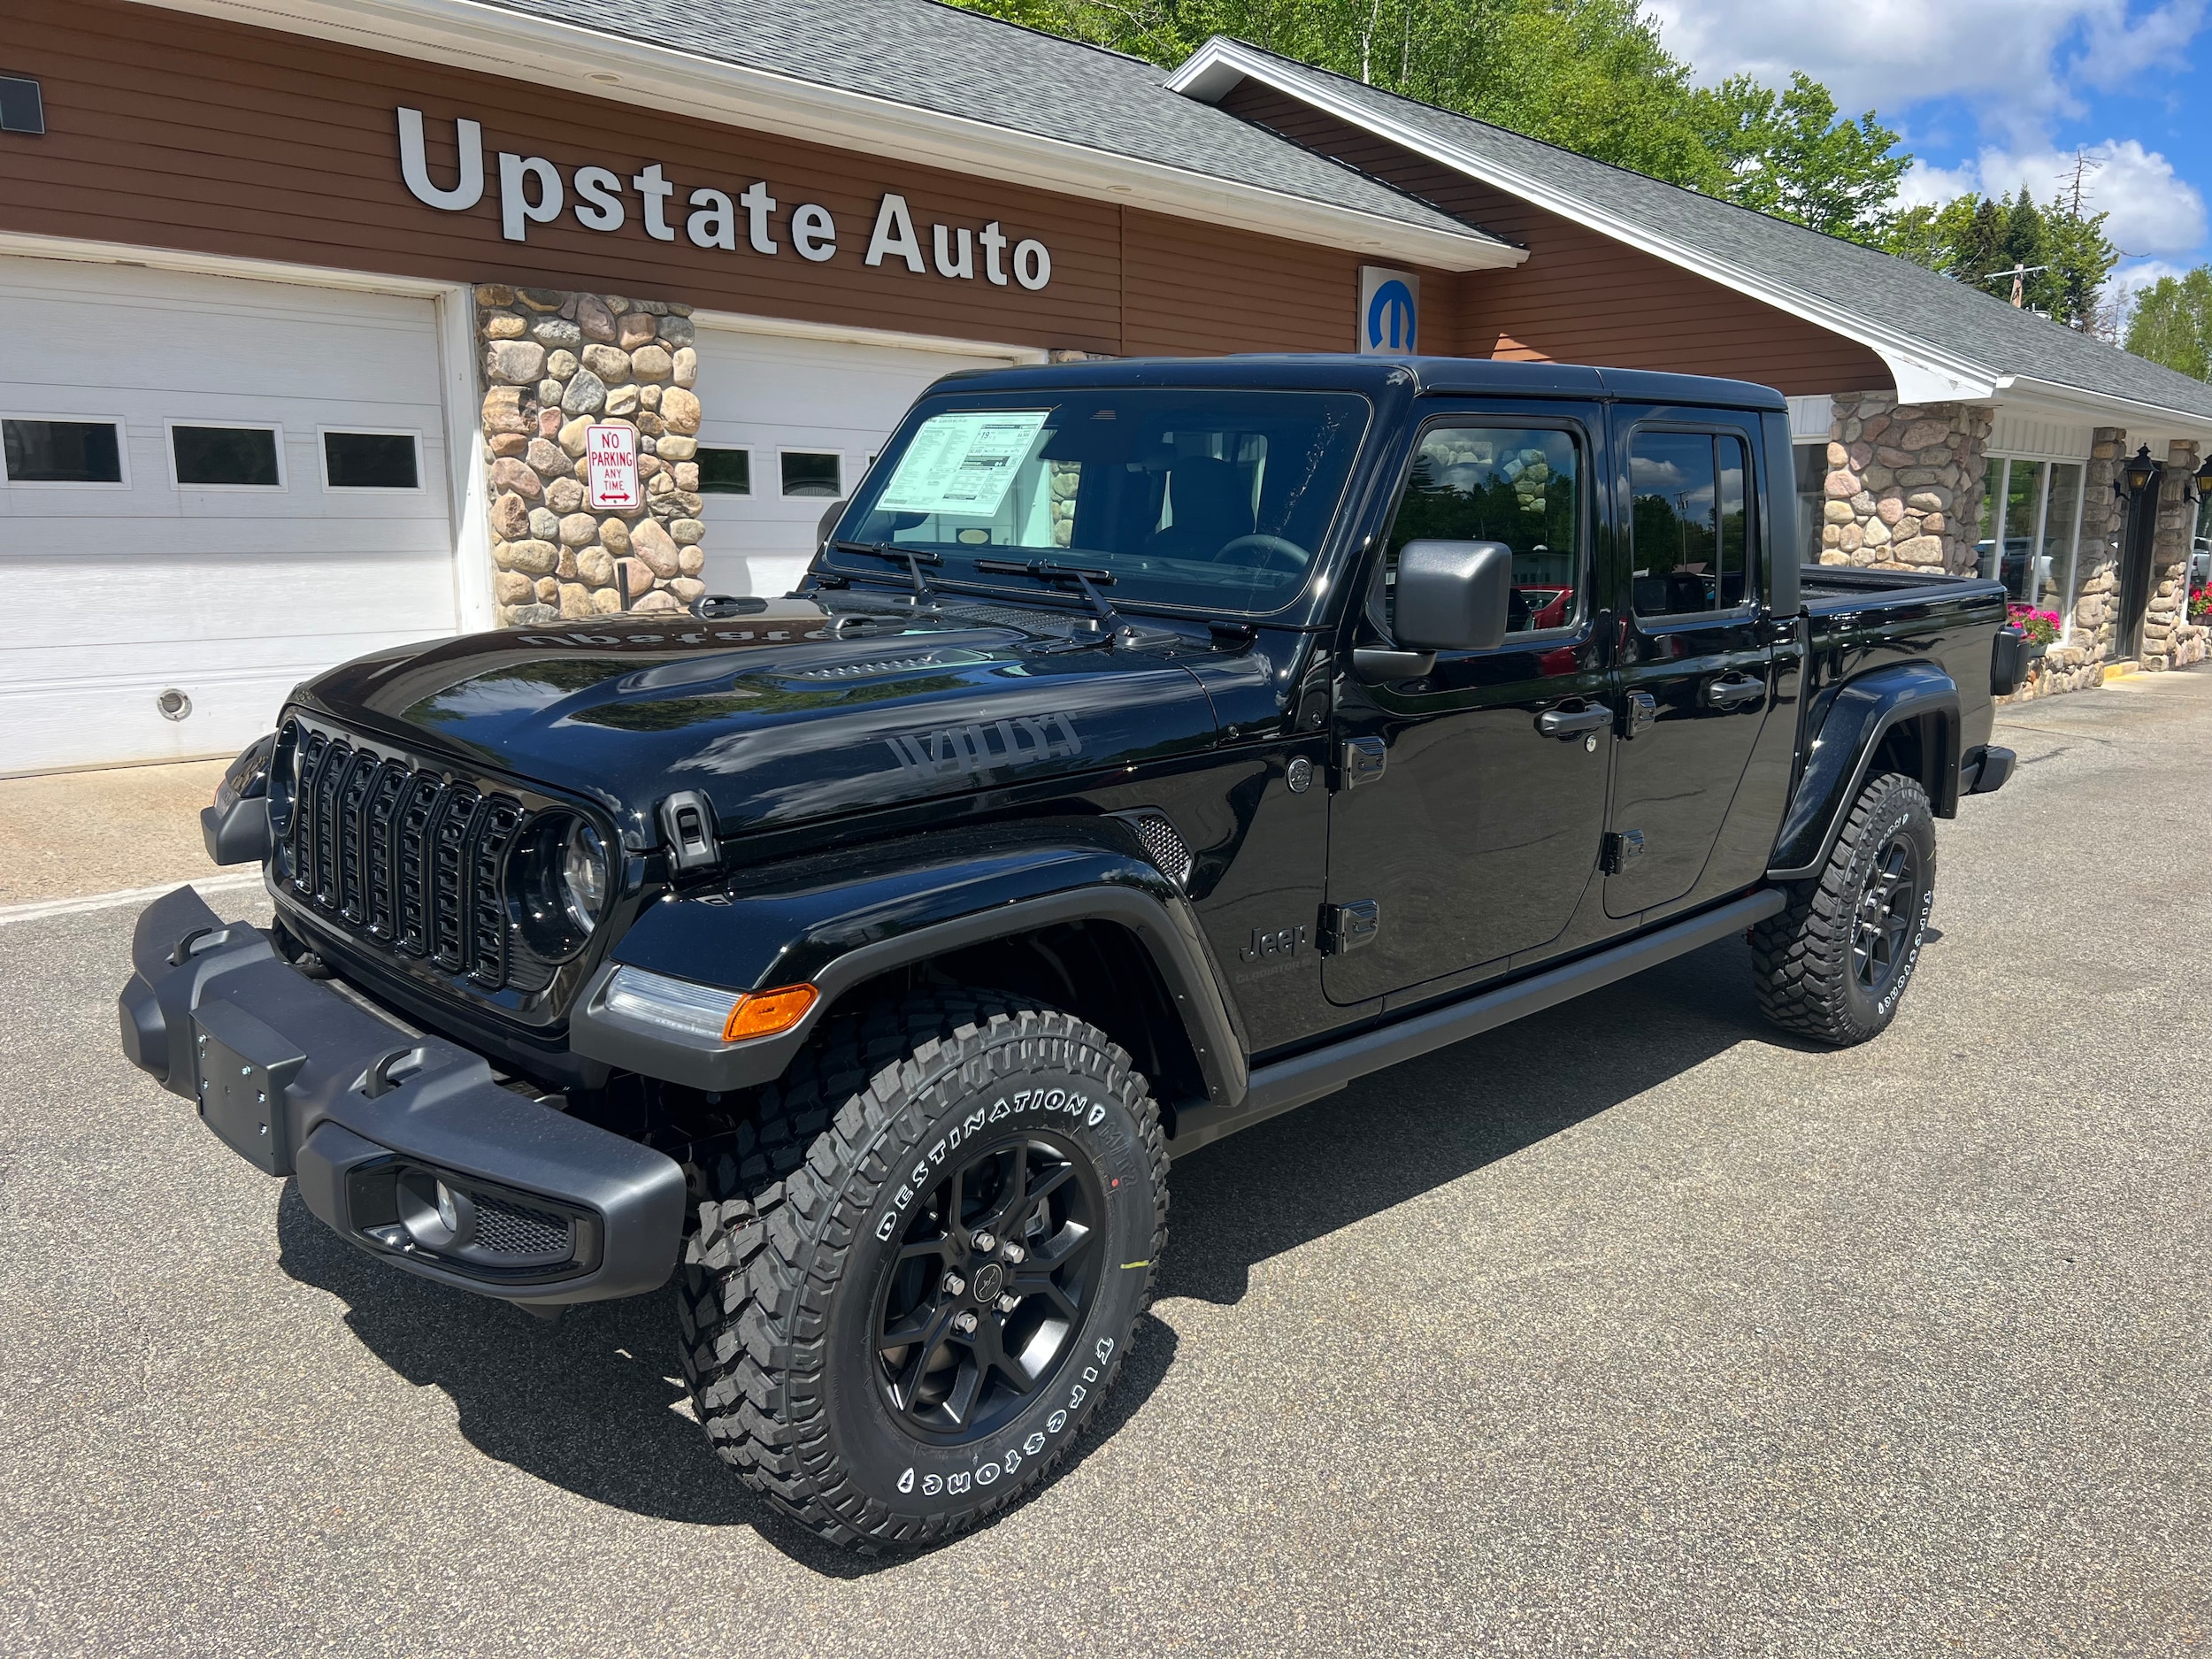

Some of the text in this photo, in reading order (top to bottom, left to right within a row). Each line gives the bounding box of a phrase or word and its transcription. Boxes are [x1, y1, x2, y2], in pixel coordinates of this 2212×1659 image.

[396, 106, 1052, 292] Upstate Auto
[602, 433, 619, 449] NO
[592, 451, 633, 467] PARKING
[604, 468, 622, 479] ANY
[604, 480, 625, 491] TIME
[885, 710, 1082, 780] WILLYS
[1239, 924, 1308, 964] Jeep
[876, 1087, 1088, 1241] DESTINATION
